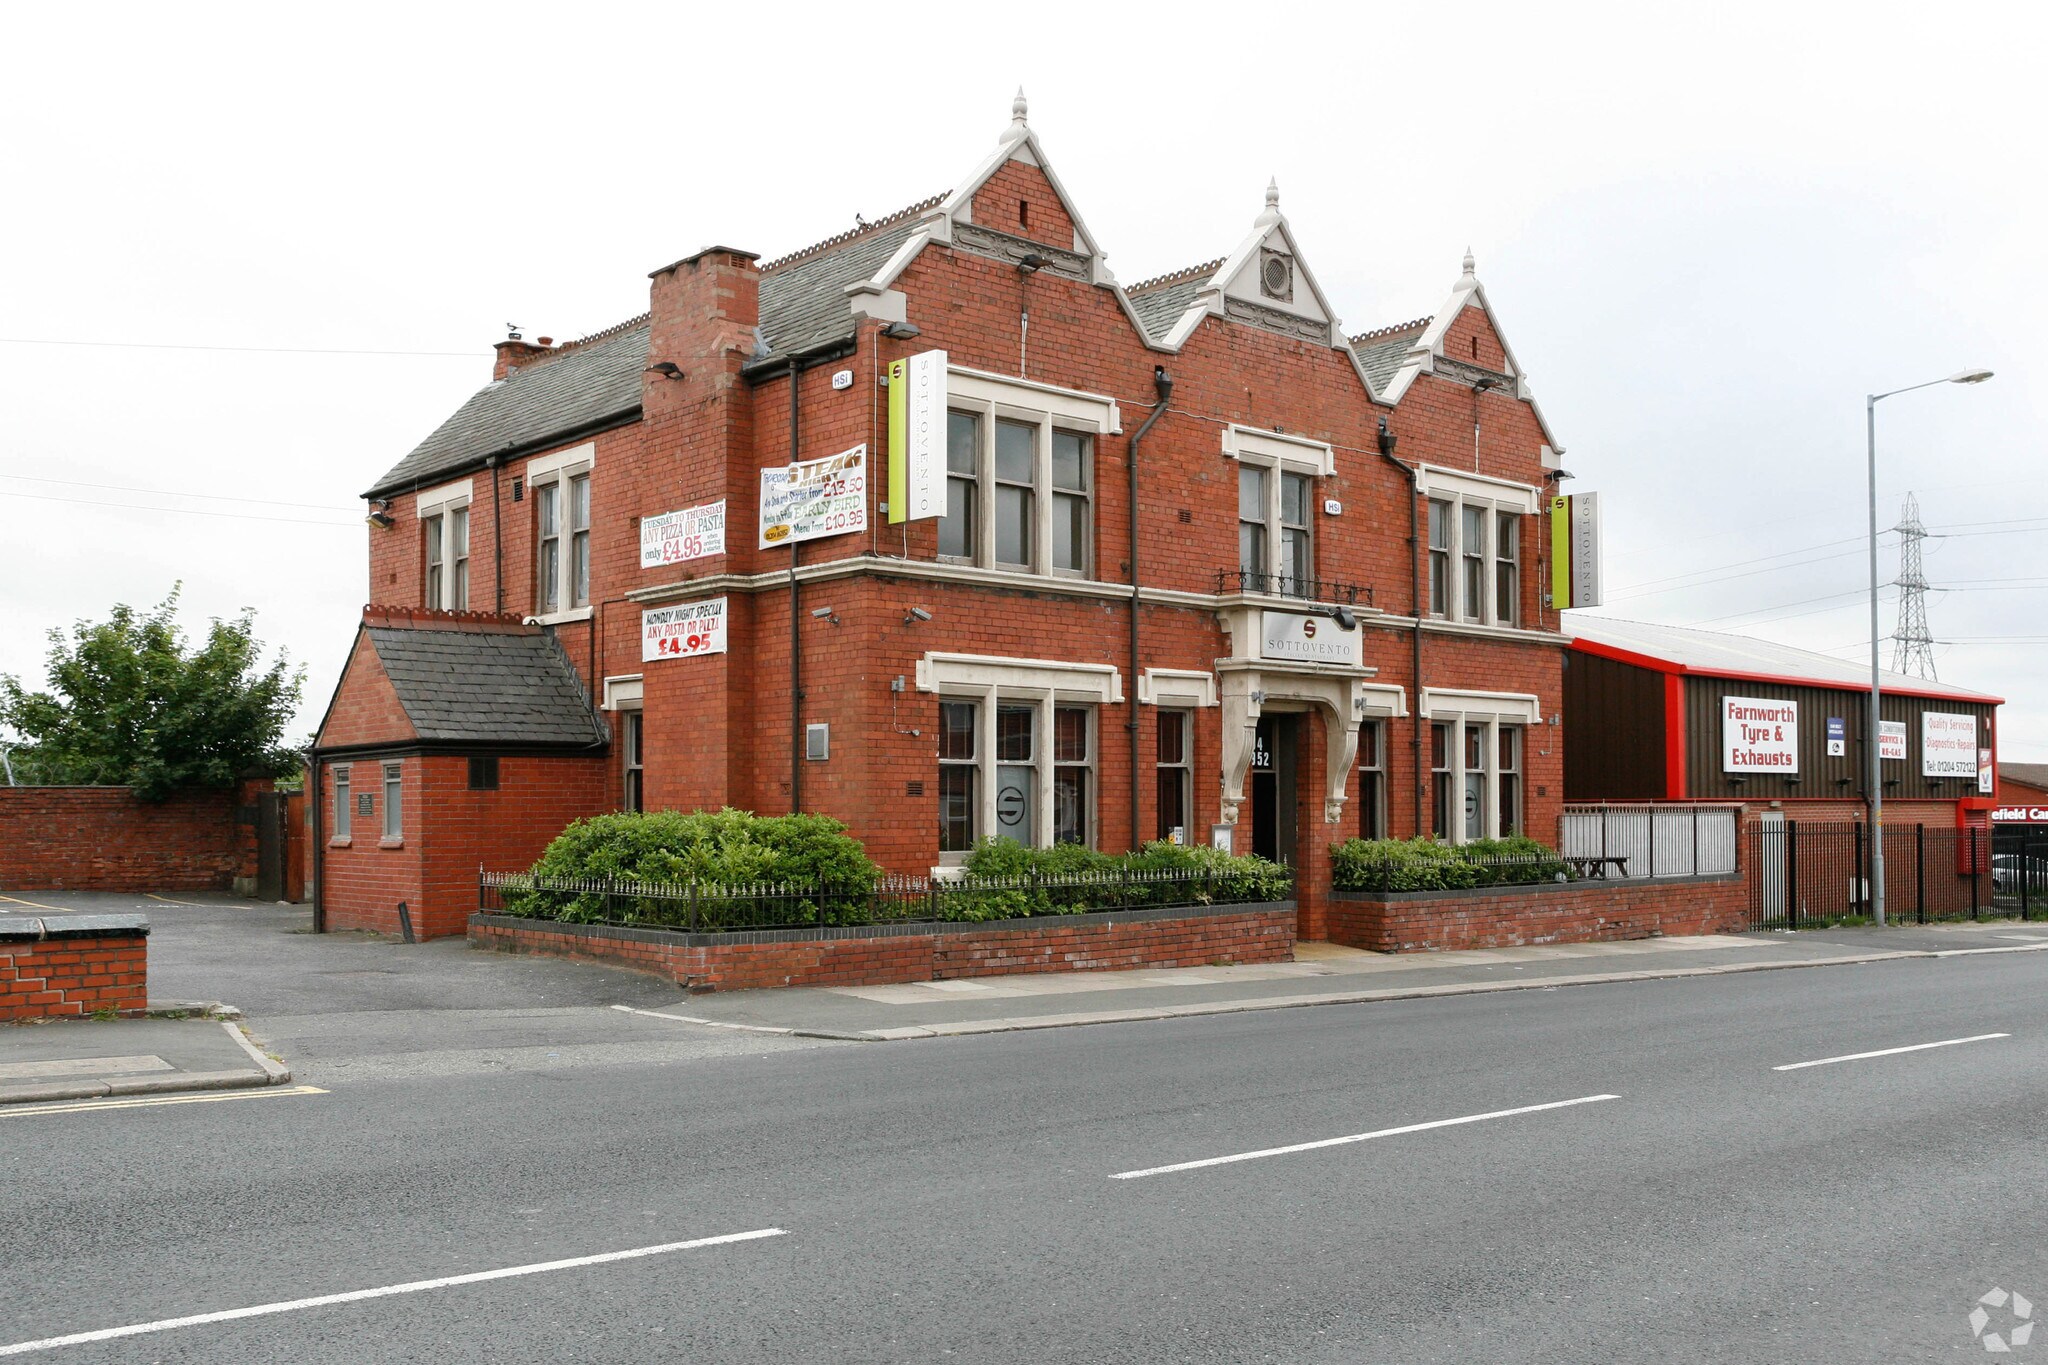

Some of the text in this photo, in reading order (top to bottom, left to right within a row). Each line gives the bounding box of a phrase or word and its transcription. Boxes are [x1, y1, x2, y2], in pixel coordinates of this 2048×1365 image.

[920, 360, 929, 511] SOTTOVENTO
[787, 449, 862, 485] STEAK
[799, 471, 840, 488] NIGHT
[823, 476, 863, 497] £13.50
[644, 504, 724, 529] TUESDAY TO THURSDAY
[794, 499, 831, 519] EARLY
[834, 495, 860, 513] BIRD
[643, 514, 724, 545] ANY PIZZA OR PASTA
[825, 509, 863, 530] £10.95
[645, 534, 702, 561] only £4.95
[1582, 497, 1591, 602] SOTTOVENTO
[646, 603, 722, 625] MONDAY NIGHT SPECIAL
[647, 617, 719, 639] ANY PASTA OR PIZZA
[658, 633, 711, 656] £4.95
[1268, 639, 1350, 655] SOTTOVENTO
[1728, 702, 1794, 722] Farnworth
[1740, 723, 1783, 745] Tyre &
[1950, 719, 1973, 734] Servicing
[1732, 748, 1792, 766] Exhausts
[1881, 747, 1901, 757] RE-GAS
[1937, 760, 1955, 772] 01204
